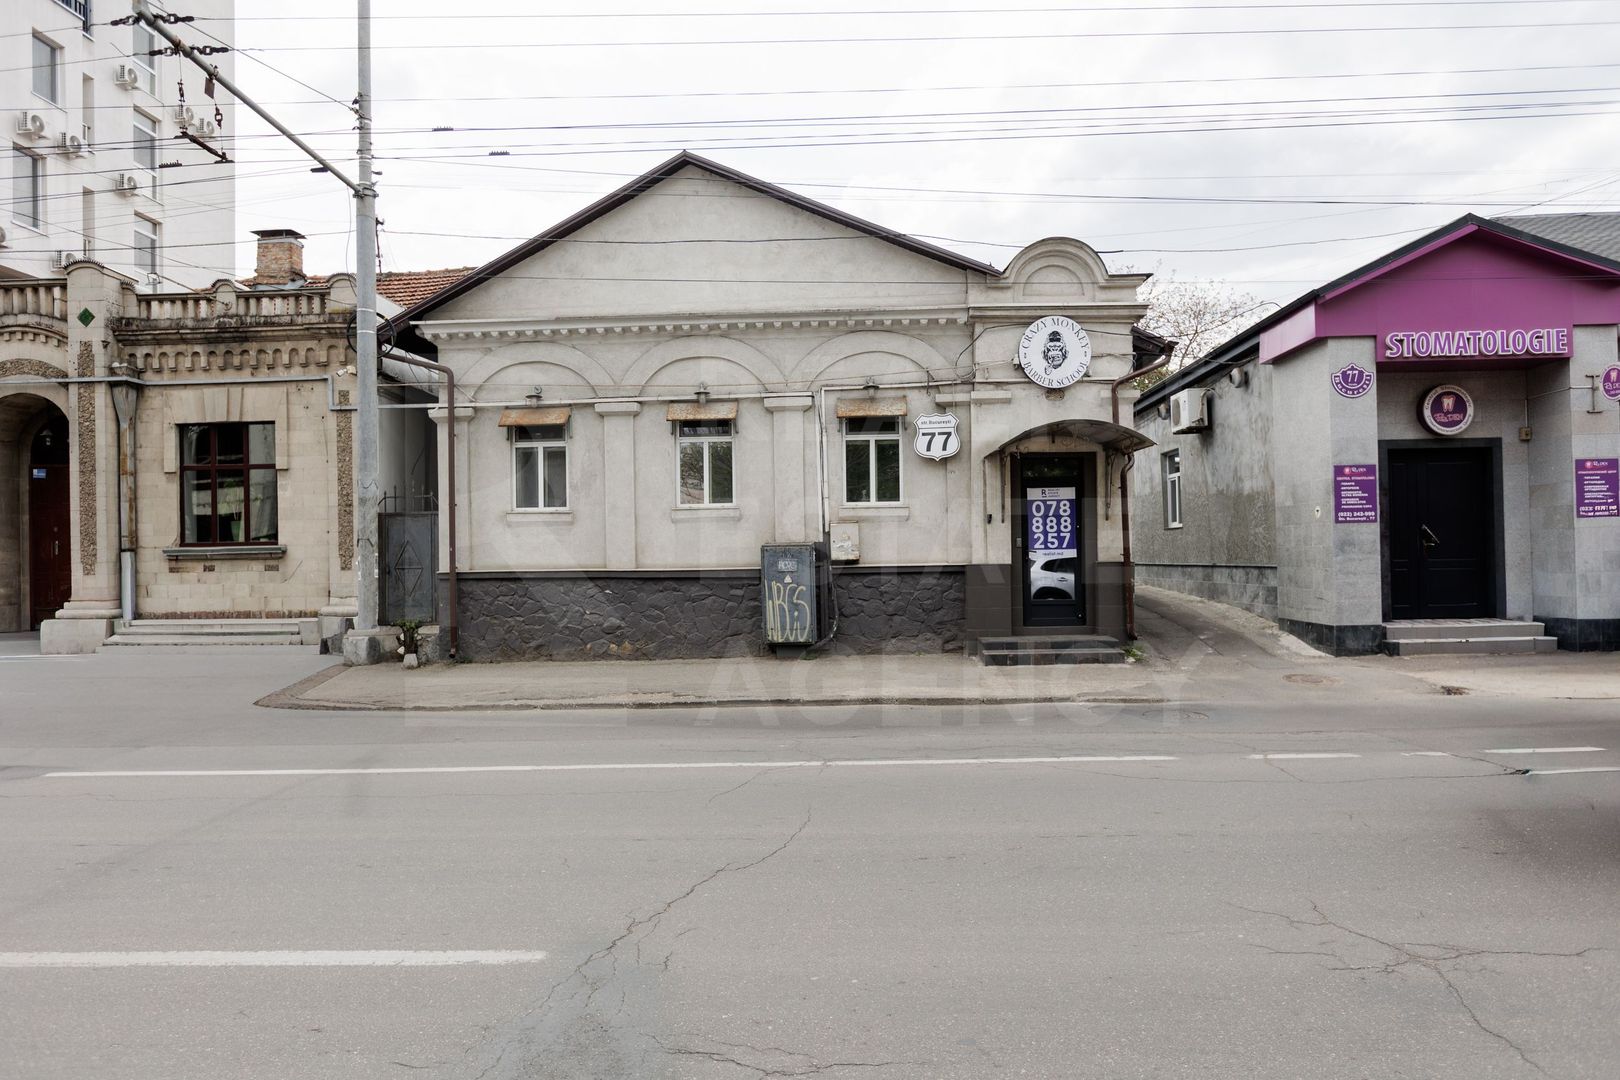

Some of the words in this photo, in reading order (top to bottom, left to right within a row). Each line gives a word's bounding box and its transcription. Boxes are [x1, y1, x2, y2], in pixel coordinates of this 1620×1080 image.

[1021, 320, 1047, 349] CRAZY
[1051, 317, 1089, 349] MONKEY
[1385, 328, 1569, 358] STOMATOLOGIE
[1023, 362, 1054, 387] BARBER
[1056, 360, 1089, 387] SCHOOL
[1346, 370, 1359, 382] 77
[922, 431, 952, 453] 77
[1032, 500, 1071, 517] 078
[1032, 516, 1072, 533] 888
[1033, 532, 1072, 549] 257
